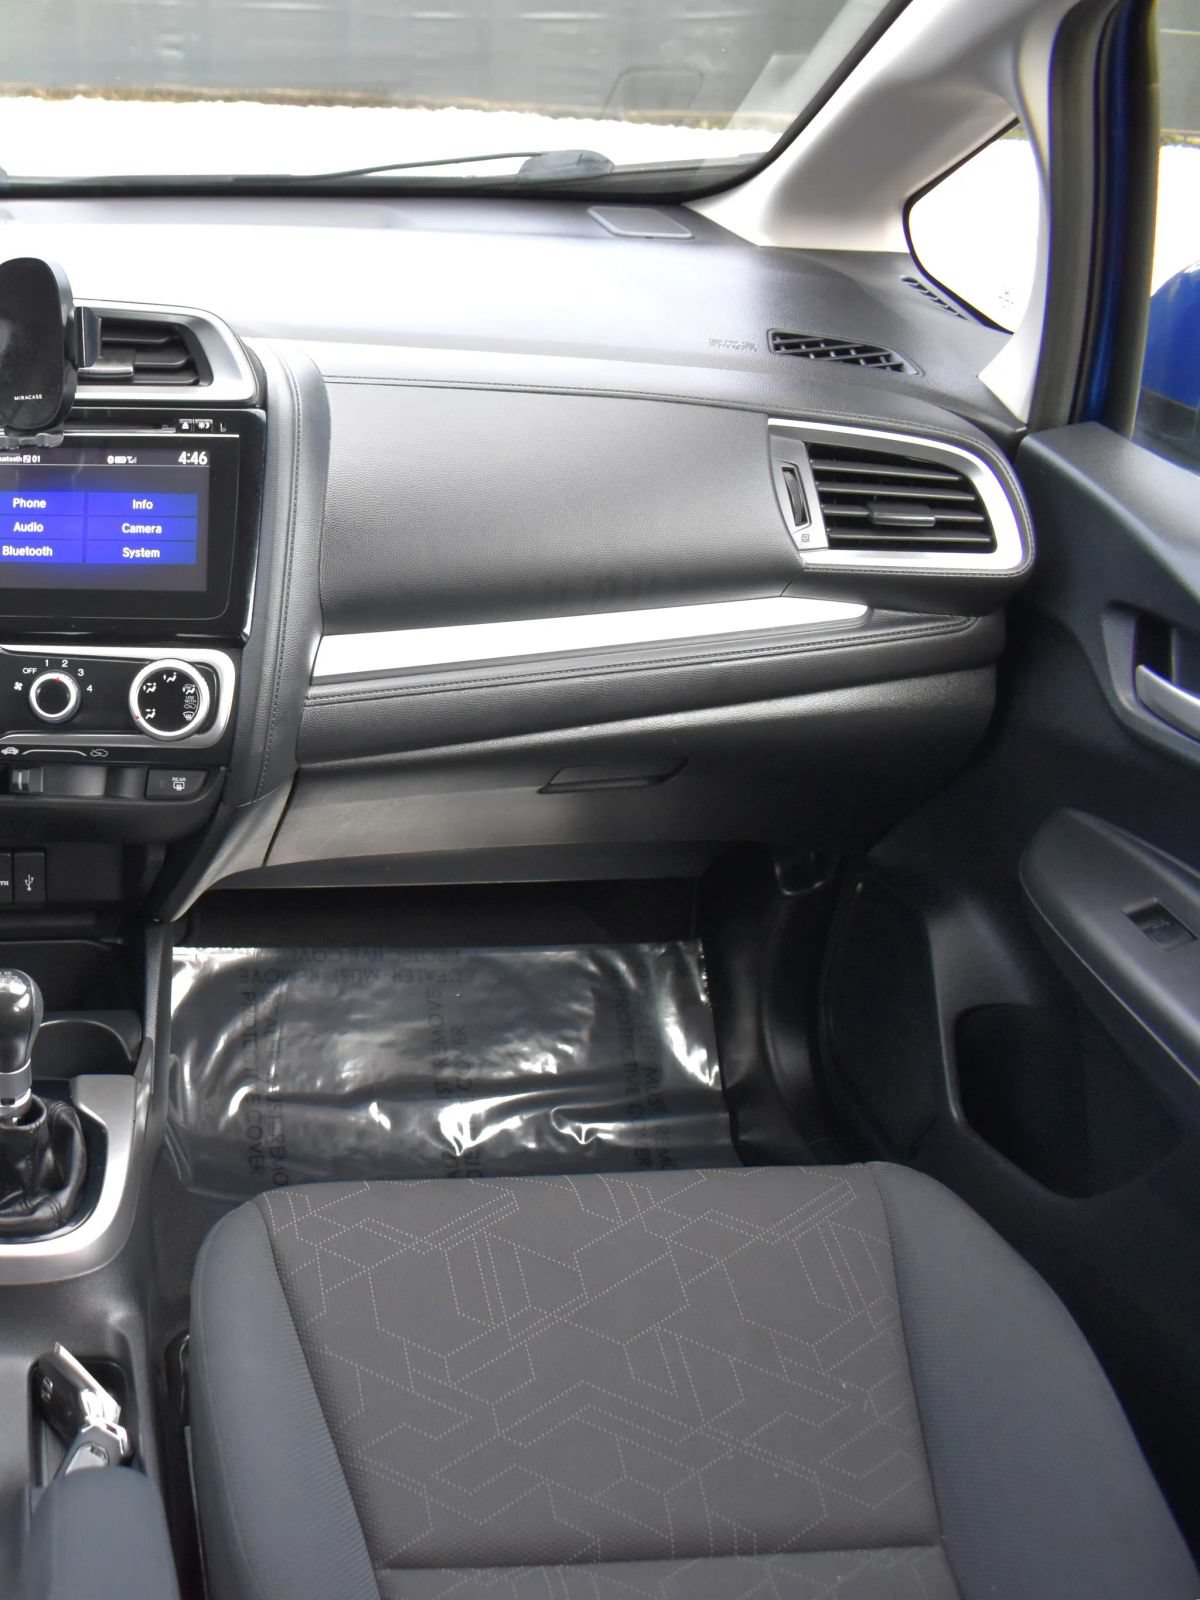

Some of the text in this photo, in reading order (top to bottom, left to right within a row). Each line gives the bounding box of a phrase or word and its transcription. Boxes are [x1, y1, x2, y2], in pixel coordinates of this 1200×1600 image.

[32, 455, 41, 463] 01
[178, 451, 208, 465] 4:46
[12, 498, 47, 509] Phone
[132, 499, 154, 510] Info
[13, 522, 44, 533] Audio
[121, 523, 162, 534] Camera
[2, 546, 53, 557] Bluetooth
[122, 547, 161, 559] System
[61, 659, 69, 668] 2
[77, 668, 85, 676] 3
[392, 967, 463, 984] DEALER
[450, 1025, 472, 1091] COVER
[246, 1110, 266, 1176] COVER
